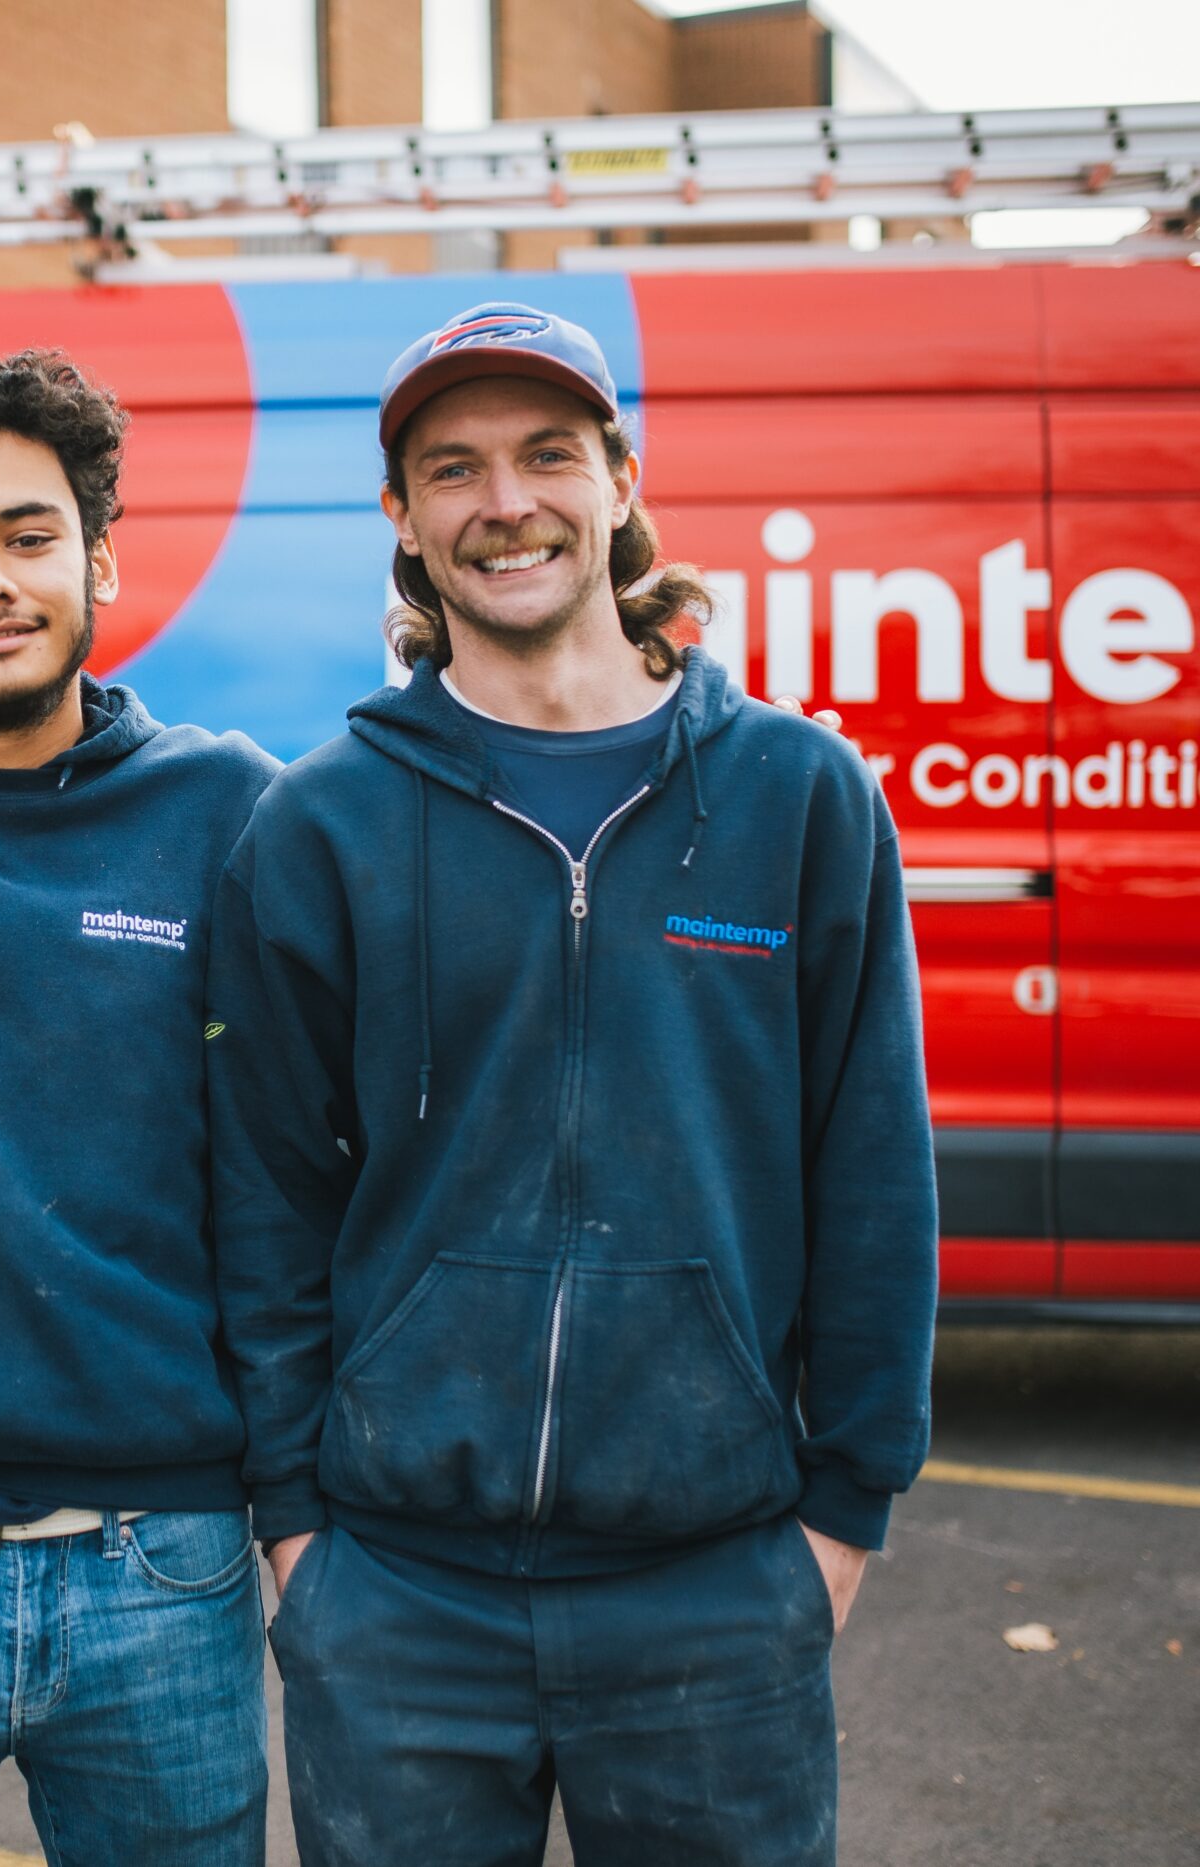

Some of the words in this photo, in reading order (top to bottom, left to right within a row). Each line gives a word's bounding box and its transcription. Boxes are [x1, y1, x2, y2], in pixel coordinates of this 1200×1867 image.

[909, 738, 1200, 809] Conditi
[81, 927, 117, 940] Heating
[125, 932, 137, 940] Air
[137, 933, 186, 951] Conditioning
